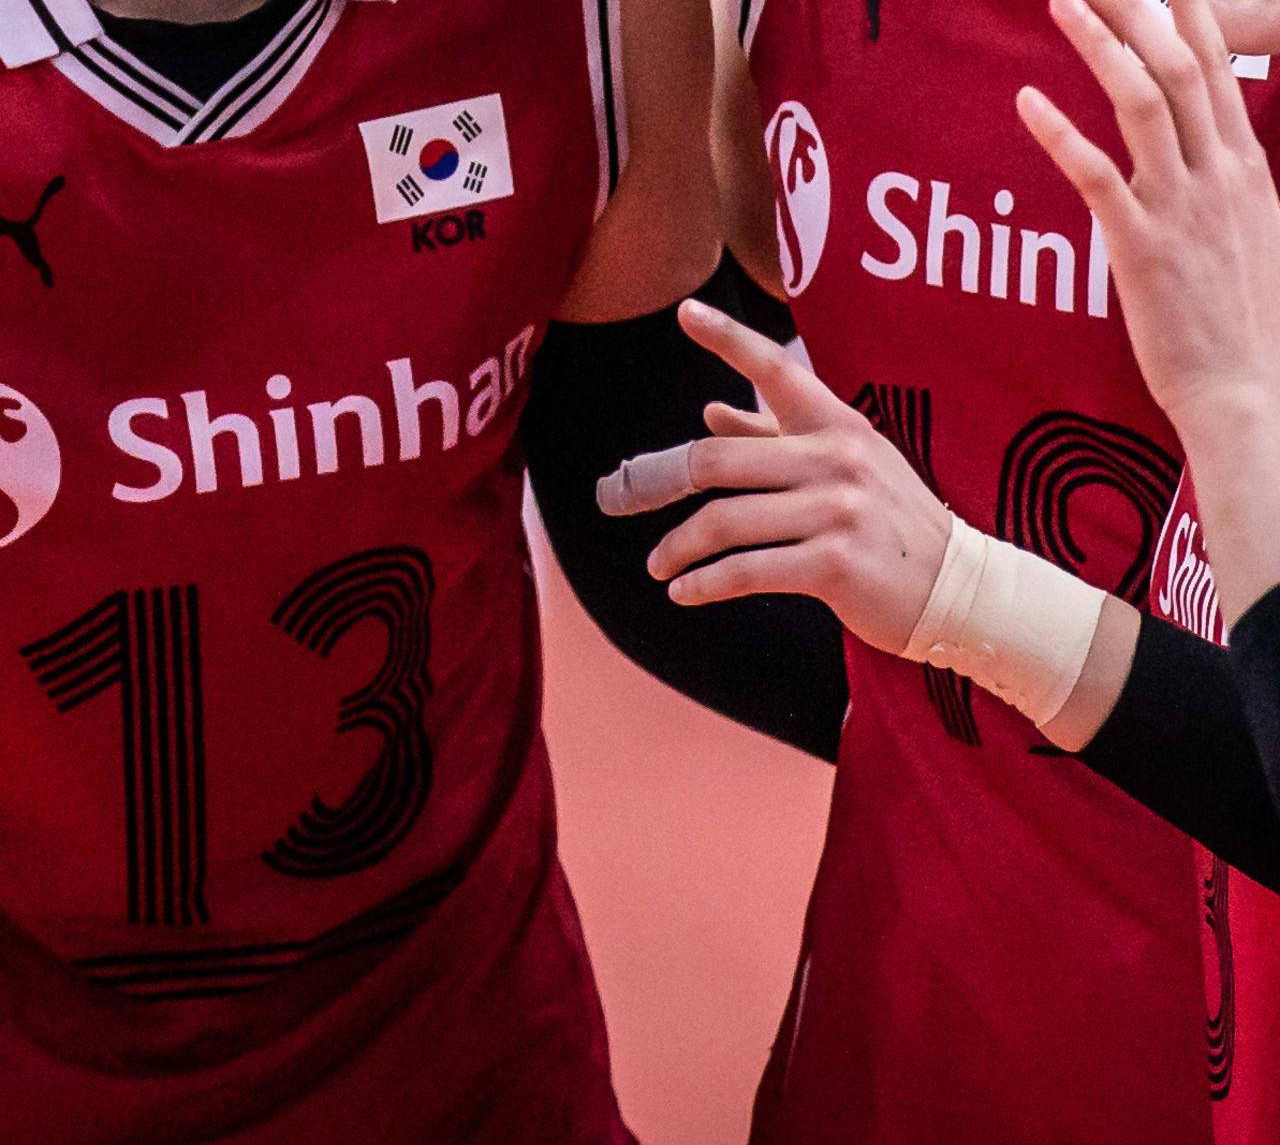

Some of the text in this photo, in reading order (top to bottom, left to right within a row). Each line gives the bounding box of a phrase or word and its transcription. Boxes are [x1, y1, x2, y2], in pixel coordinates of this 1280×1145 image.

[412, 209, 486, 253] KOR
[107, 324, 535, 503] Shinhan
[20, 544, 436, 926] 13
